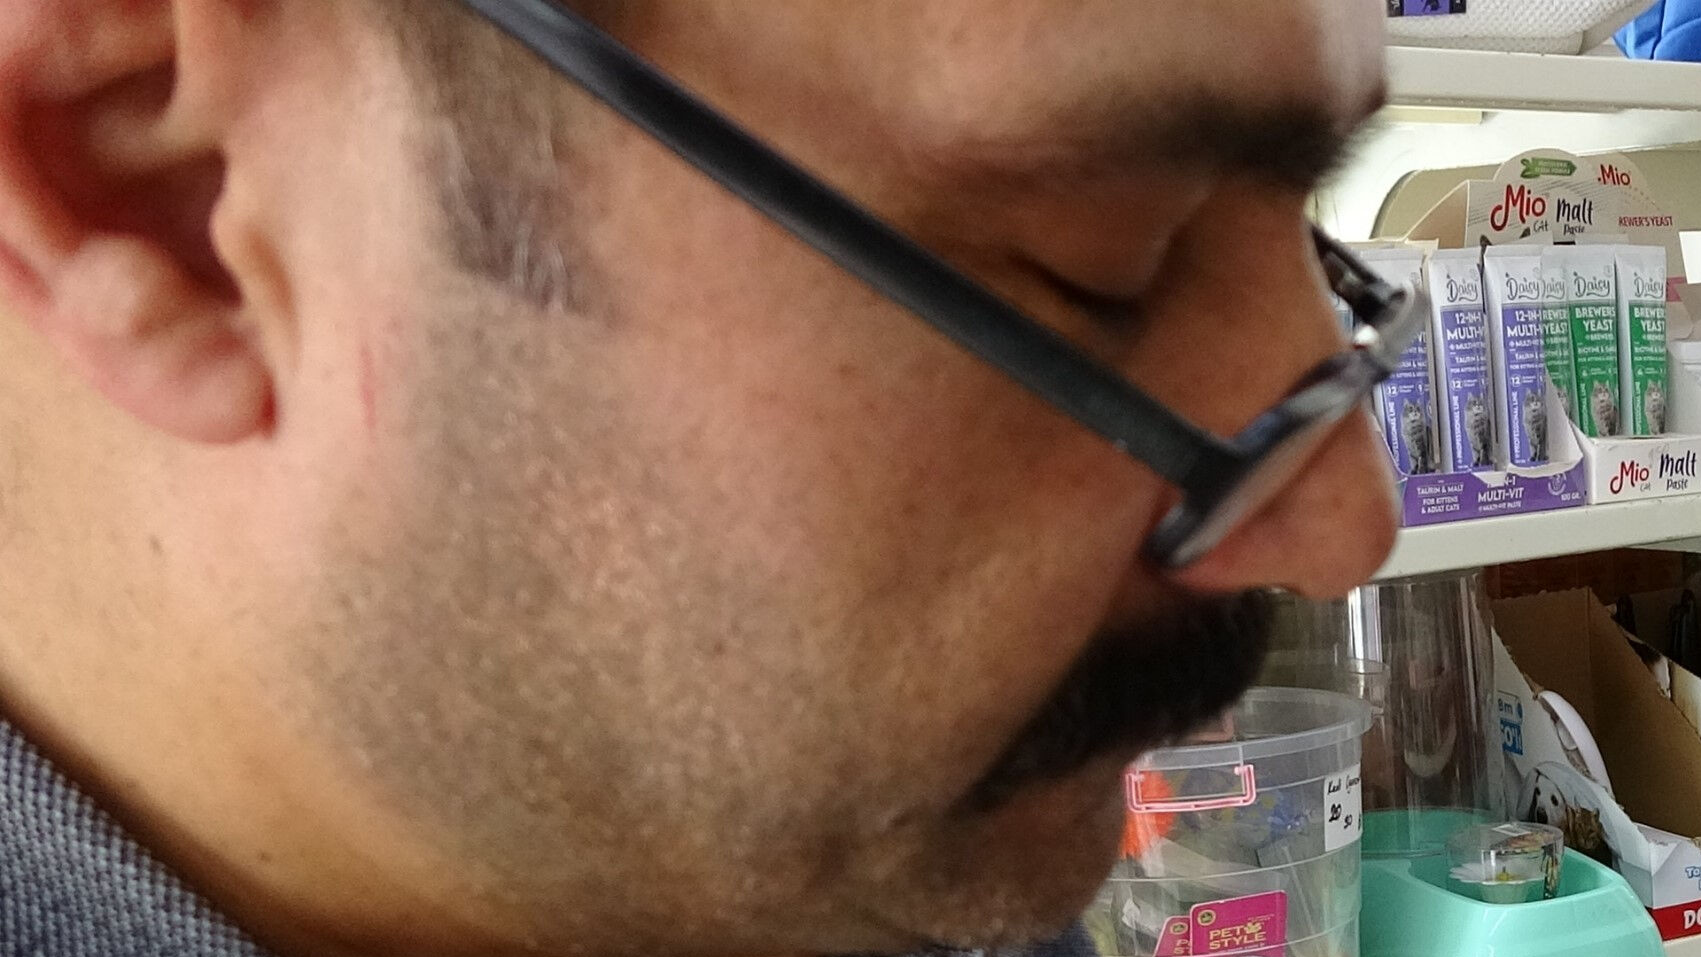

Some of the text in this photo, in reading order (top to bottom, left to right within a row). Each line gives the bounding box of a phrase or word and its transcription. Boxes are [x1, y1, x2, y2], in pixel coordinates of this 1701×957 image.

[1490, 184, 1546, 231] Mio
[1447, 274, 1479, 303] Daisy
[1505, 272, 1540, 301] Daisy
[1573, 271, 1611, 298] Daisy
[1575, 306, 1616, 319] BREWERS
[1582, 319, 1613, 332] YEAST
[1610, 460, 1650, 495] Mio
[1477, 487, 1525, 503] MULTI-VIT
[1208, 932, 1267, 951] STYLE
